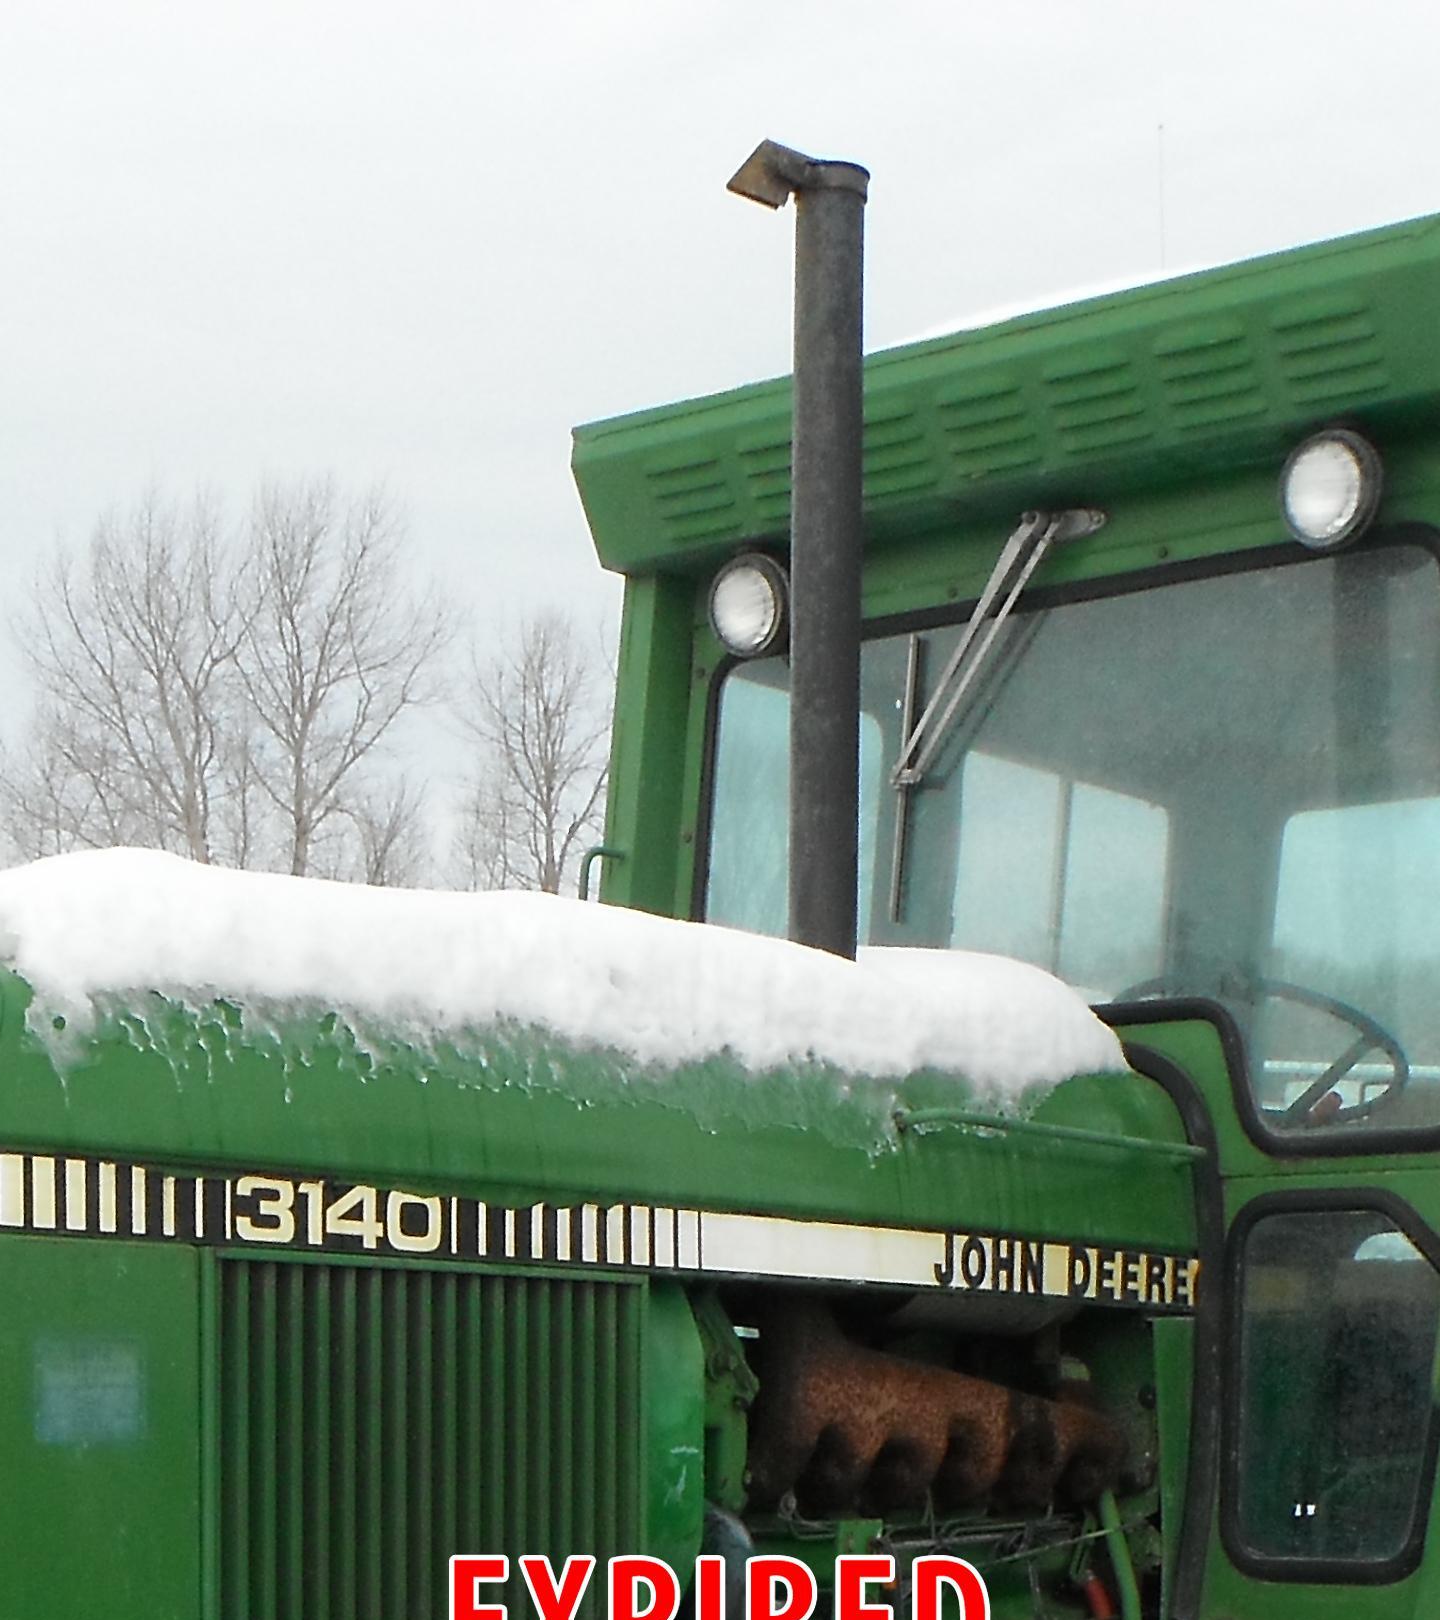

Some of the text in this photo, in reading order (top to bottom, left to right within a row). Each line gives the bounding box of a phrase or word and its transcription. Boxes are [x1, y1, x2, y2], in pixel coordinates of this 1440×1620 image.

[236, 1176, 442, 1253] 3140
[933, 1233, 1191, 1305] JOHN DEERE
